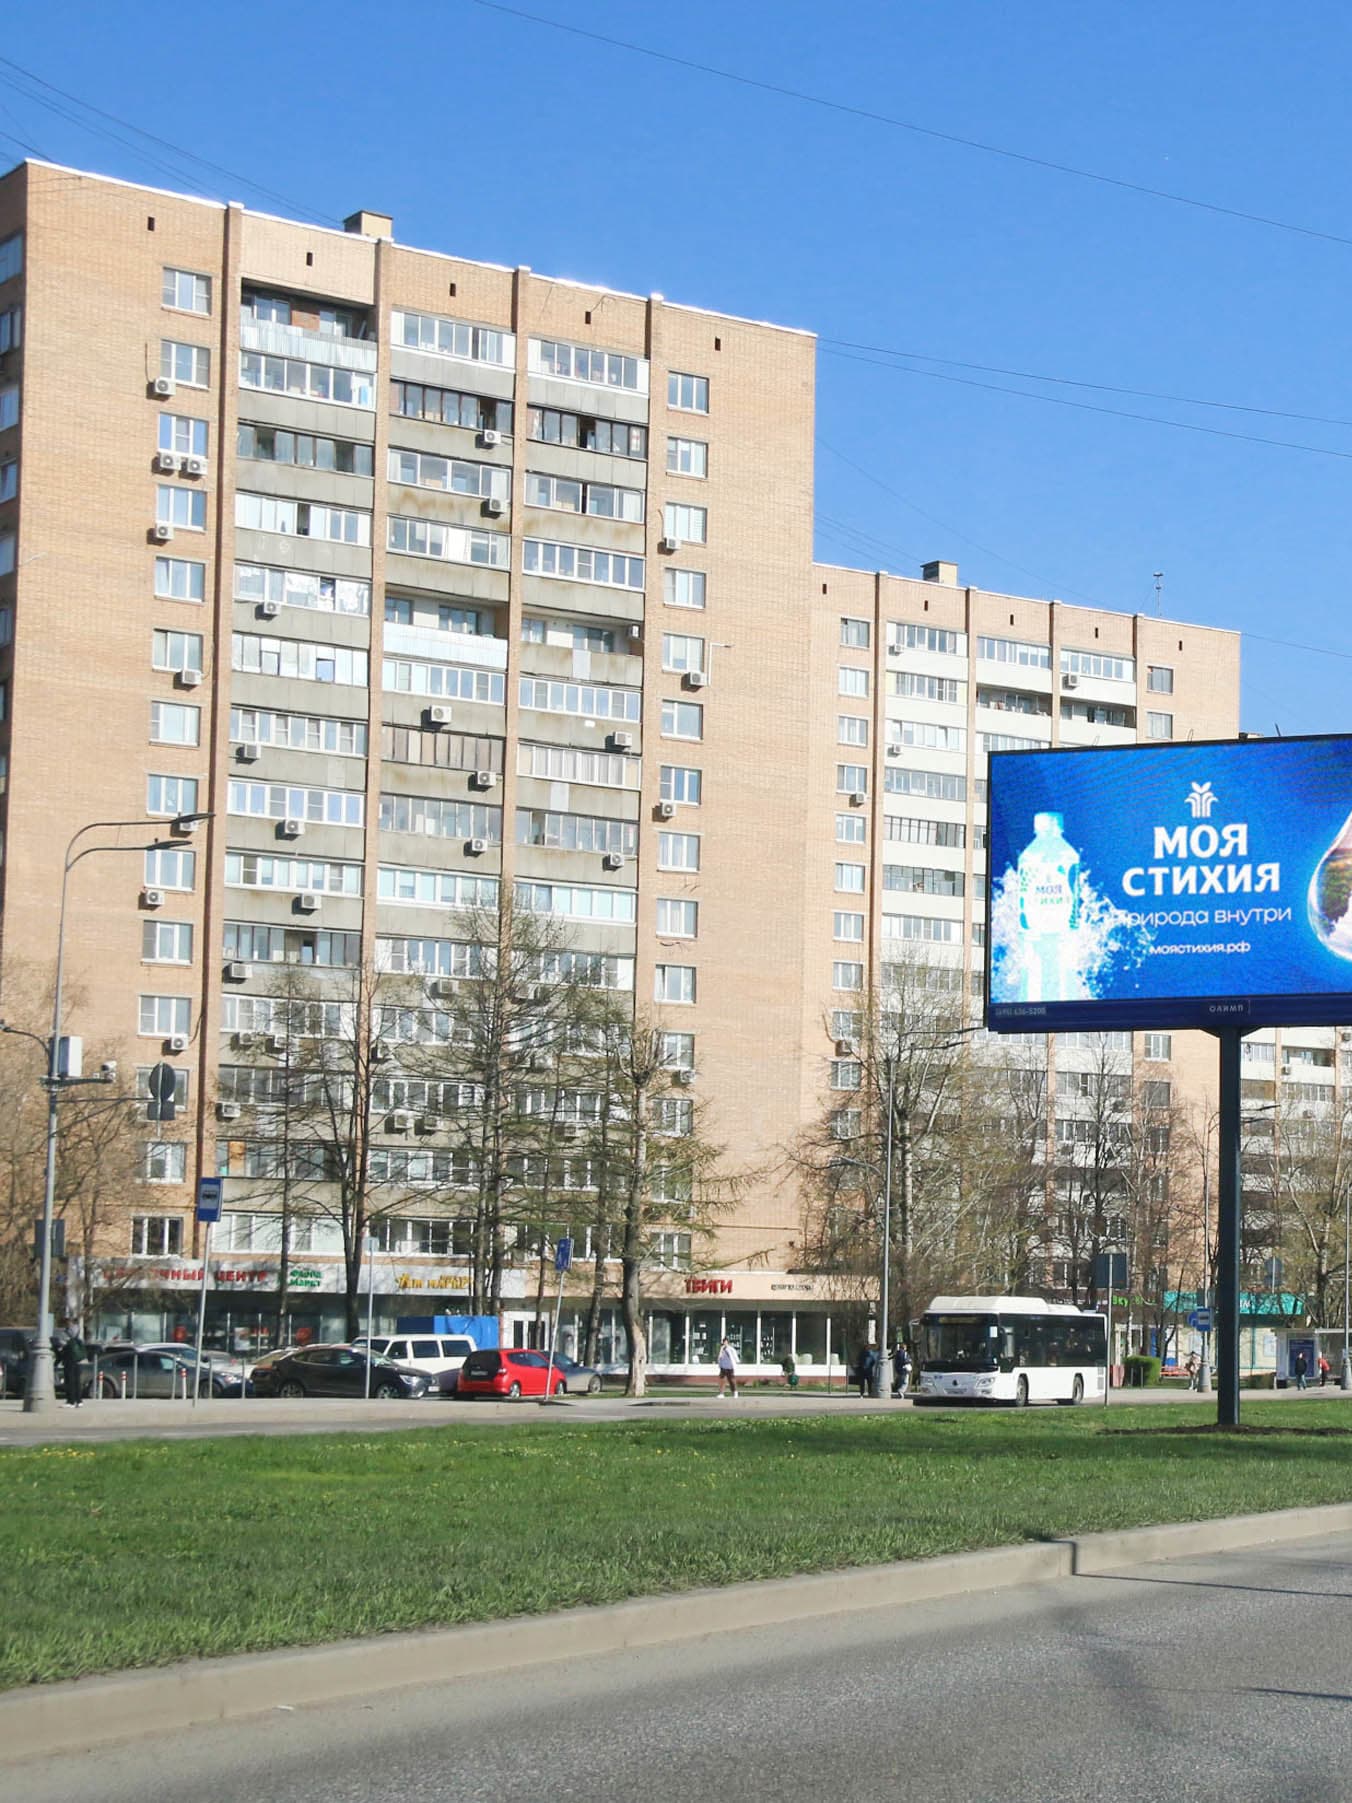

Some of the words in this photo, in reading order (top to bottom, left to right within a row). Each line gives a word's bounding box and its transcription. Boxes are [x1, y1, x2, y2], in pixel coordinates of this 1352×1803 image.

[1153, 823, 1248, 860] МОЯ
[1122, 862, 1280, 897] СТИХИЯ
[1213, 907, 1292, 926] внутри
[1209, 1004, 1244, 1013] ОЛИМП
[214, 1269, 268, 1283] ЦЕНТР
